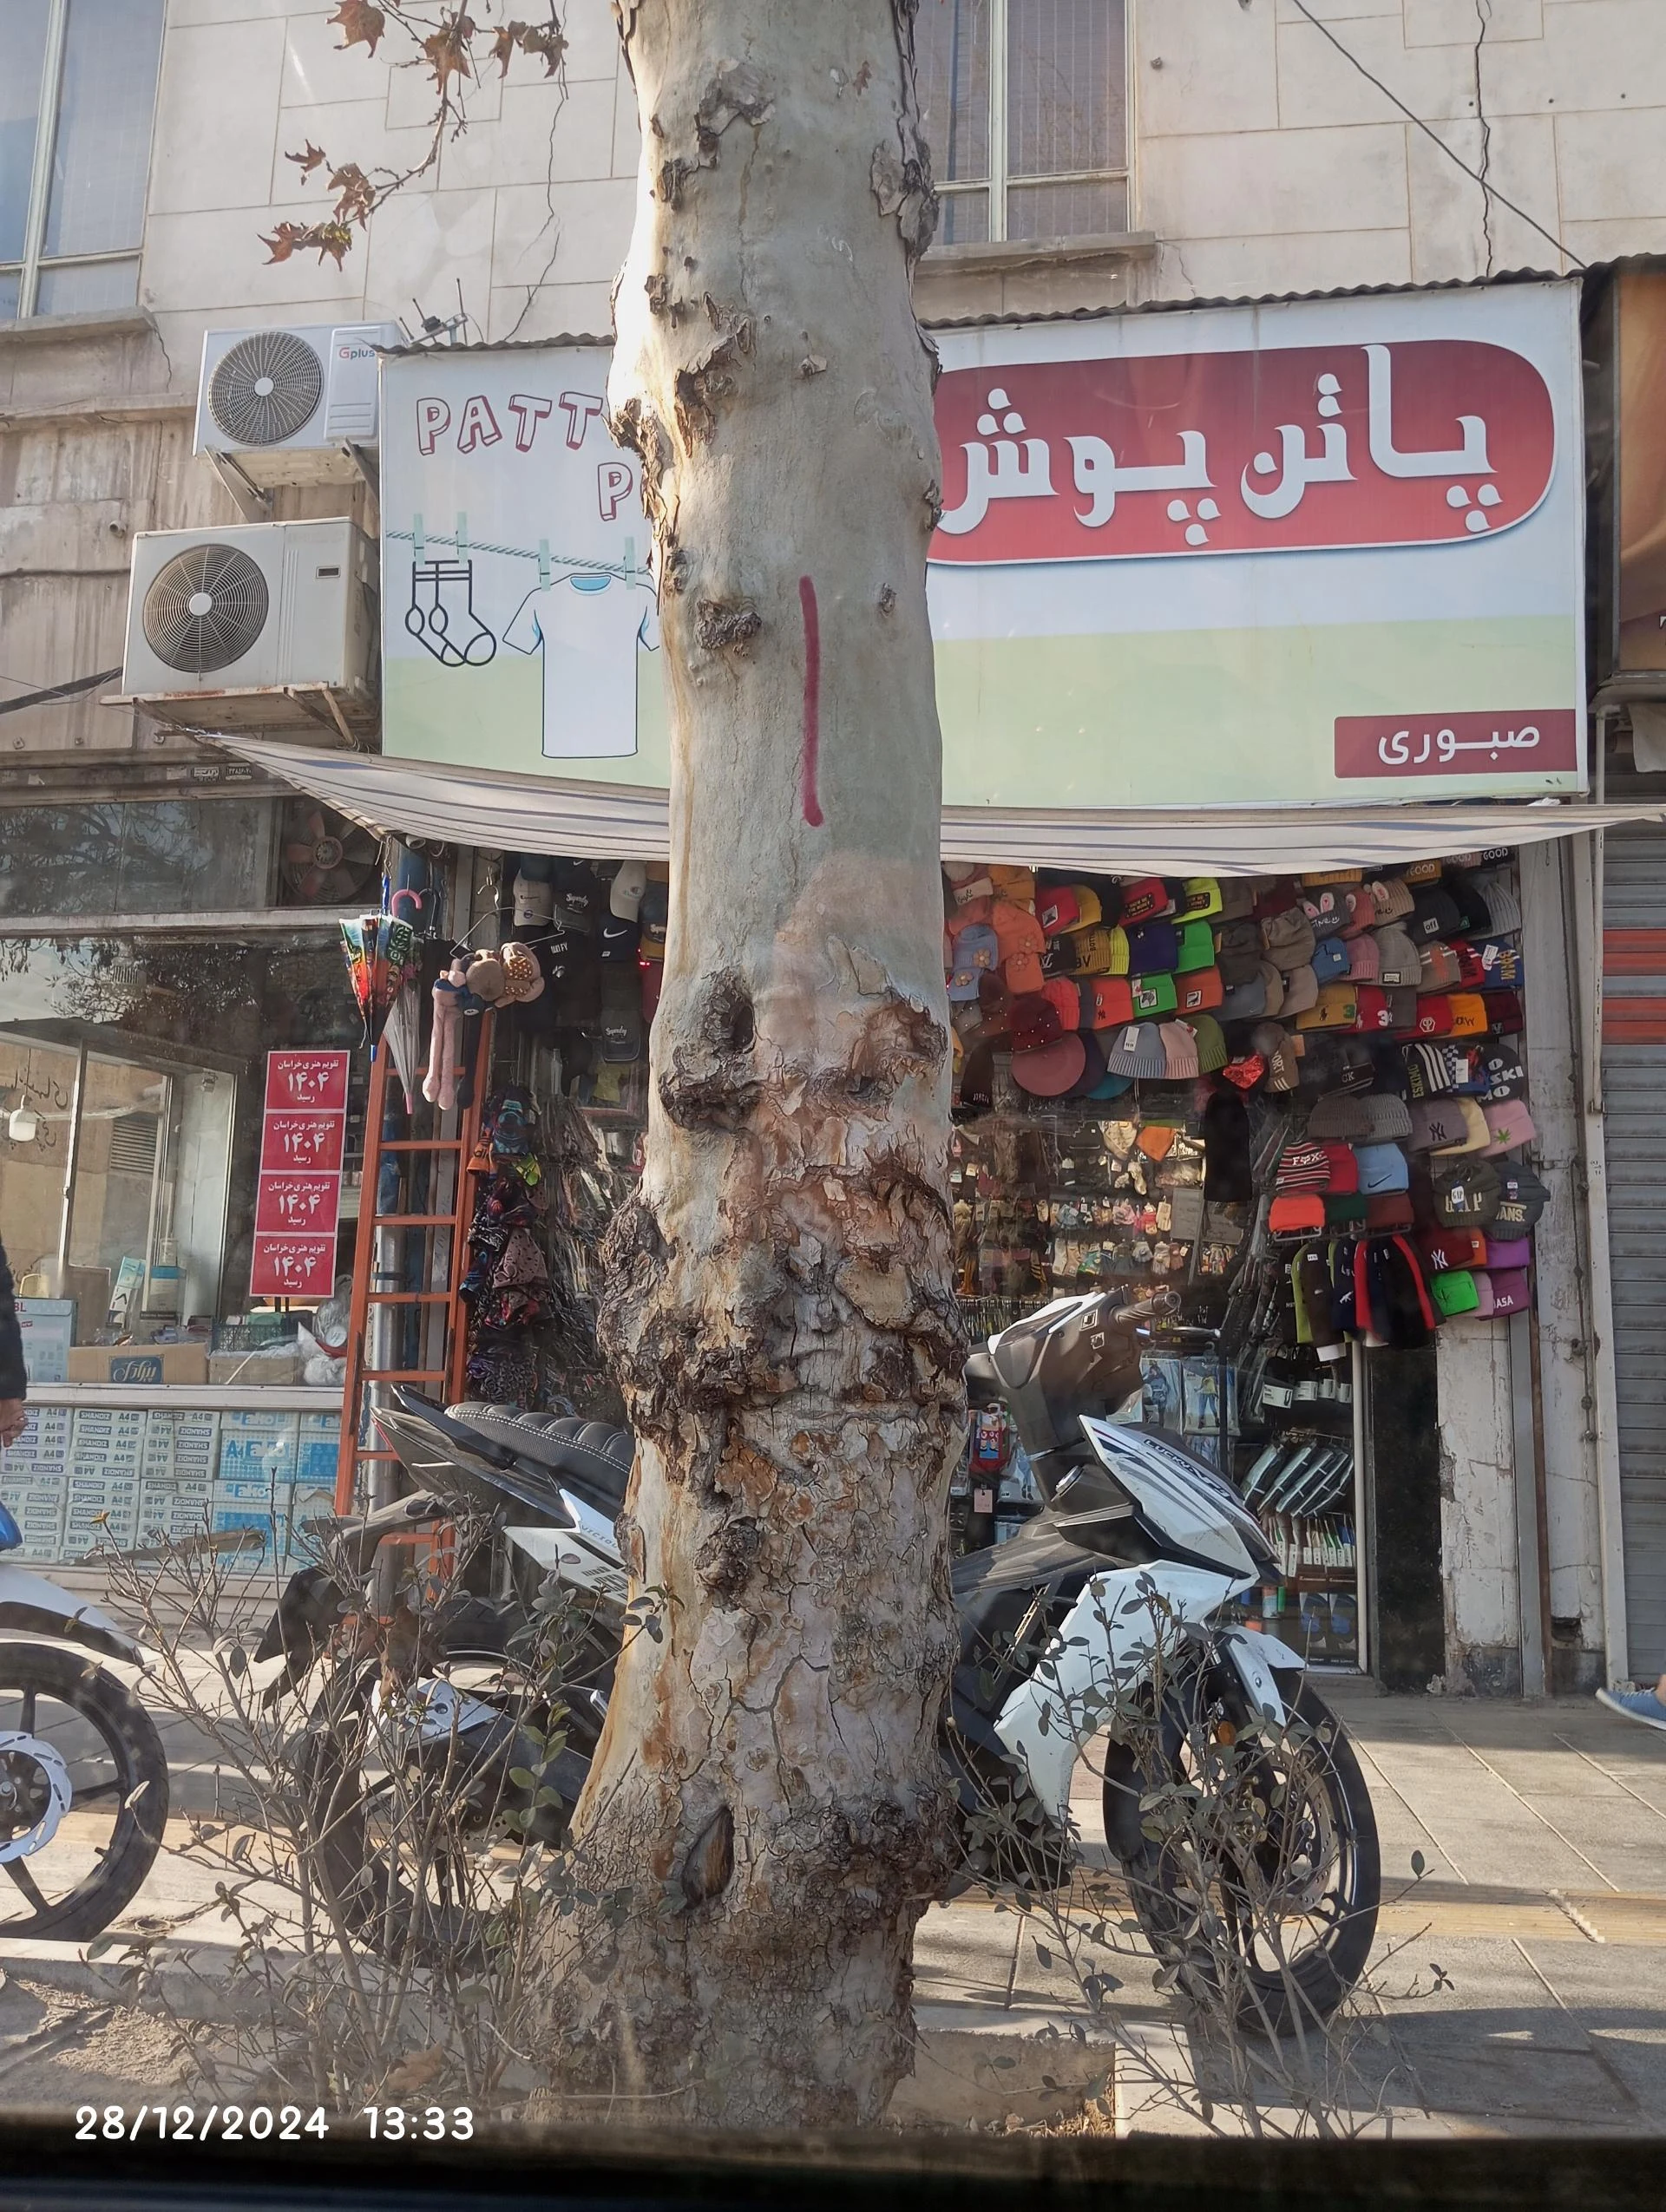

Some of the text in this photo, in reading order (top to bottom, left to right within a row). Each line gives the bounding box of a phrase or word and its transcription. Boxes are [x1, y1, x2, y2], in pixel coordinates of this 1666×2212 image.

[339, 347, 375, 360] Gplus
[416, 391, 604, 455] PATT
[935, 344, 1502, 546] پاتن پوش
[1379, 723, 1540, 765] صبوری
[278, 1060, 339, 1070] تقویم هنری خراسان
[1490, 1066, 1524, 1085] SKI
[288, 1071, 330, 1092] ۱۴۰۴
[297, 1094, 315, 1103] رسید
[273, 1121, 335, 1130] تقویم هنری خراسان
[284, 1133, 325, 1153] ۱۴۰۴
[293, 1155, 312, 1163] رسید
[268, 1181, 331, 1191] تقویم هنری خراسان
[279, 1194, 321, 1214] ۱۴۰۴
[288, 1216, 306, 1225] رسید
[263, 1243, 326, 1253] تقویم هنری خراسان
[274, 1256, 317, 1277] ۱۴۰۴
[284, 1279, 302, 1287] رسید
[80, 1411, 111, 1420] SHANDIZ
[180, 1427, 211, 1436] SHANDIZ
[177, 1441, 208, 1450] SHANDIZ
[74, 1481, 123, 1490] SHANDIZ A4
[147, 1482, 178, 1490] SHANDIZ
